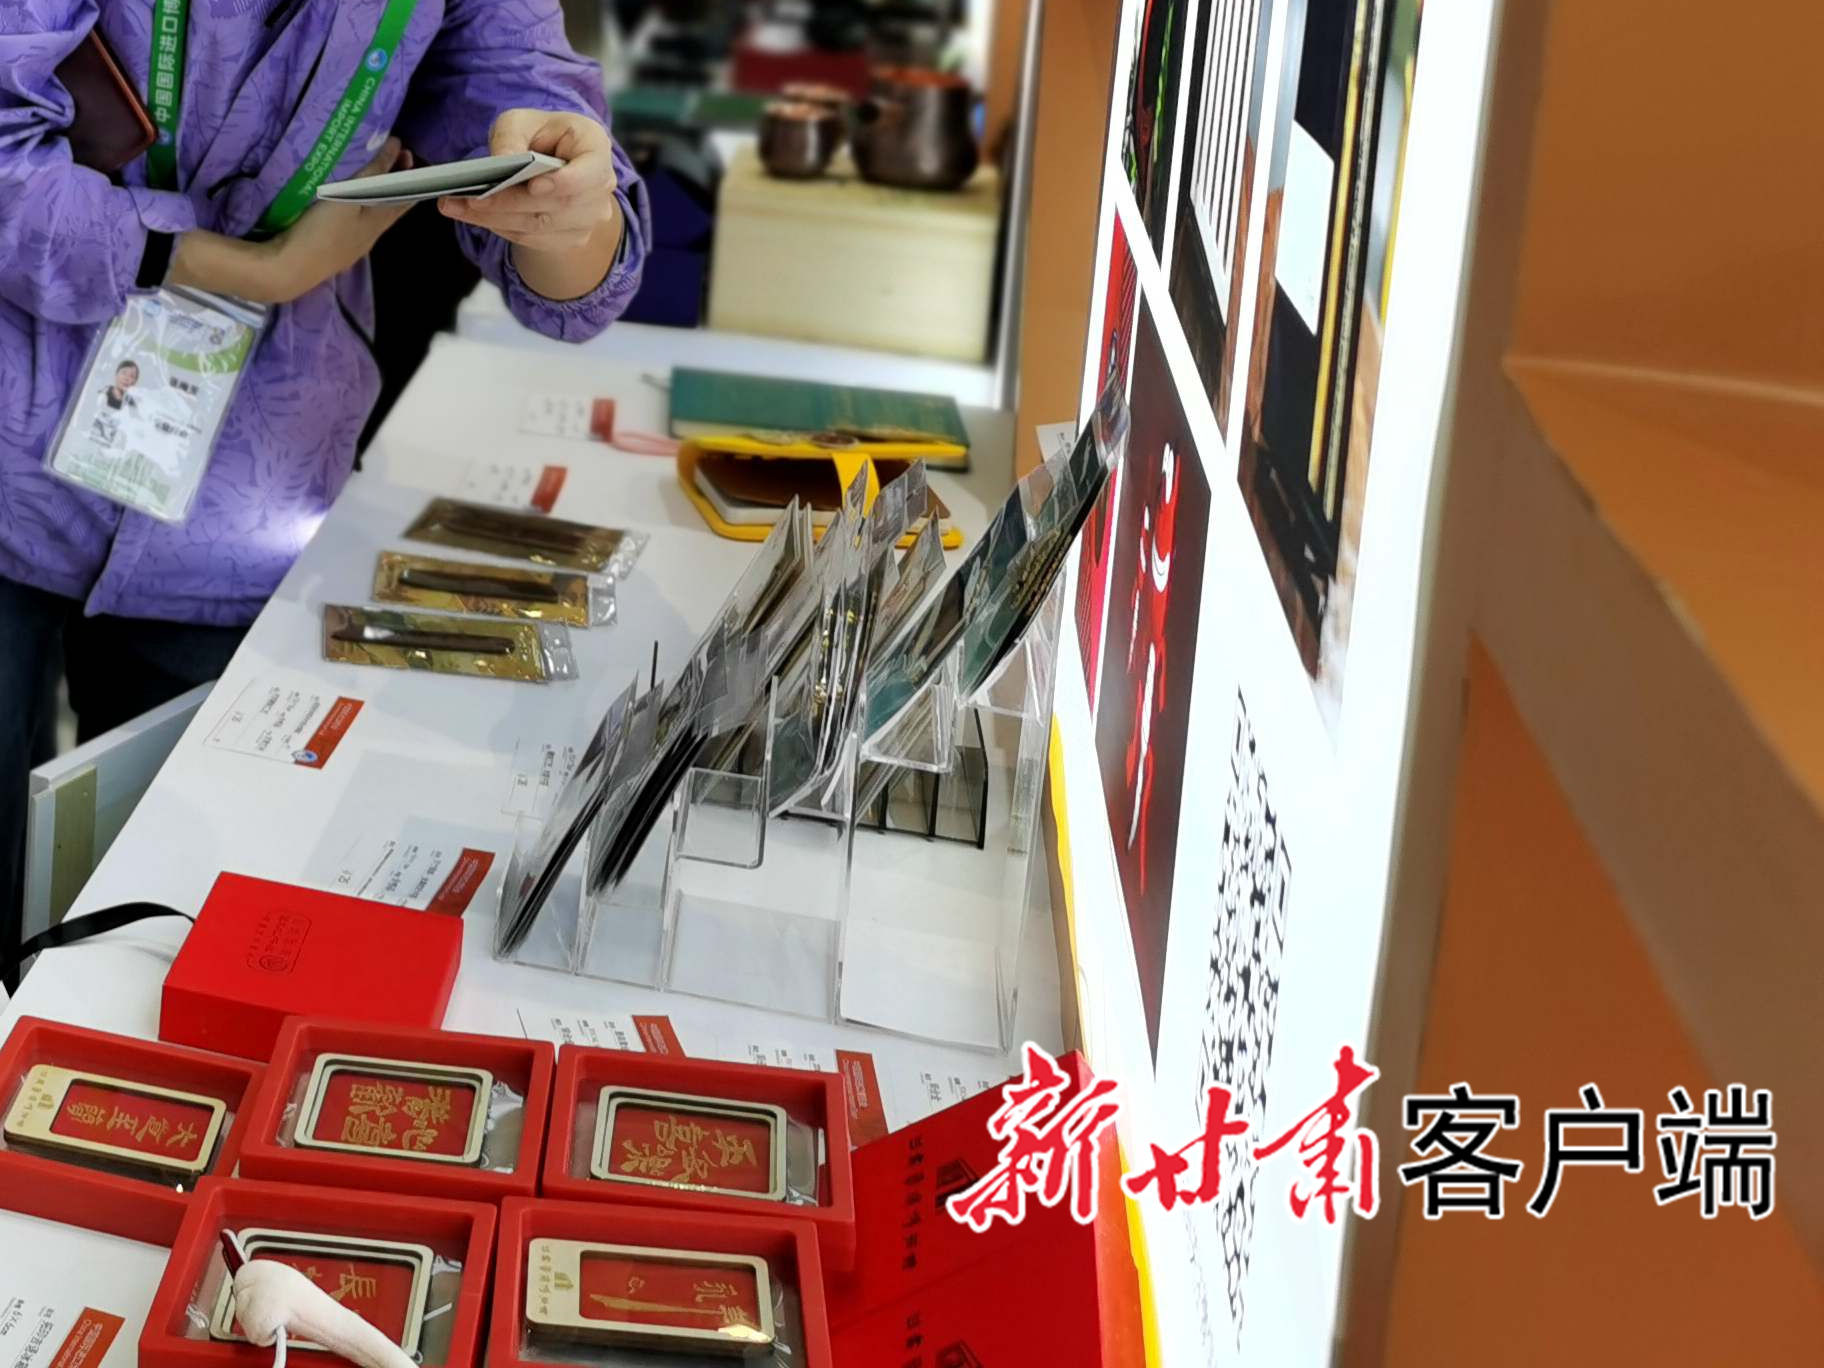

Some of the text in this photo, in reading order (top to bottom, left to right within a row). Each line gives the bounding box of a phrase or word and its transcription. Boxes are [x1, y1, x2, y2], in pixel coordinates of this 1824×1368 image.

[297, 77, 376, 196] CHINA INTERNATIONAL
[304, 98, 353, 172] IMPORT EXPO
